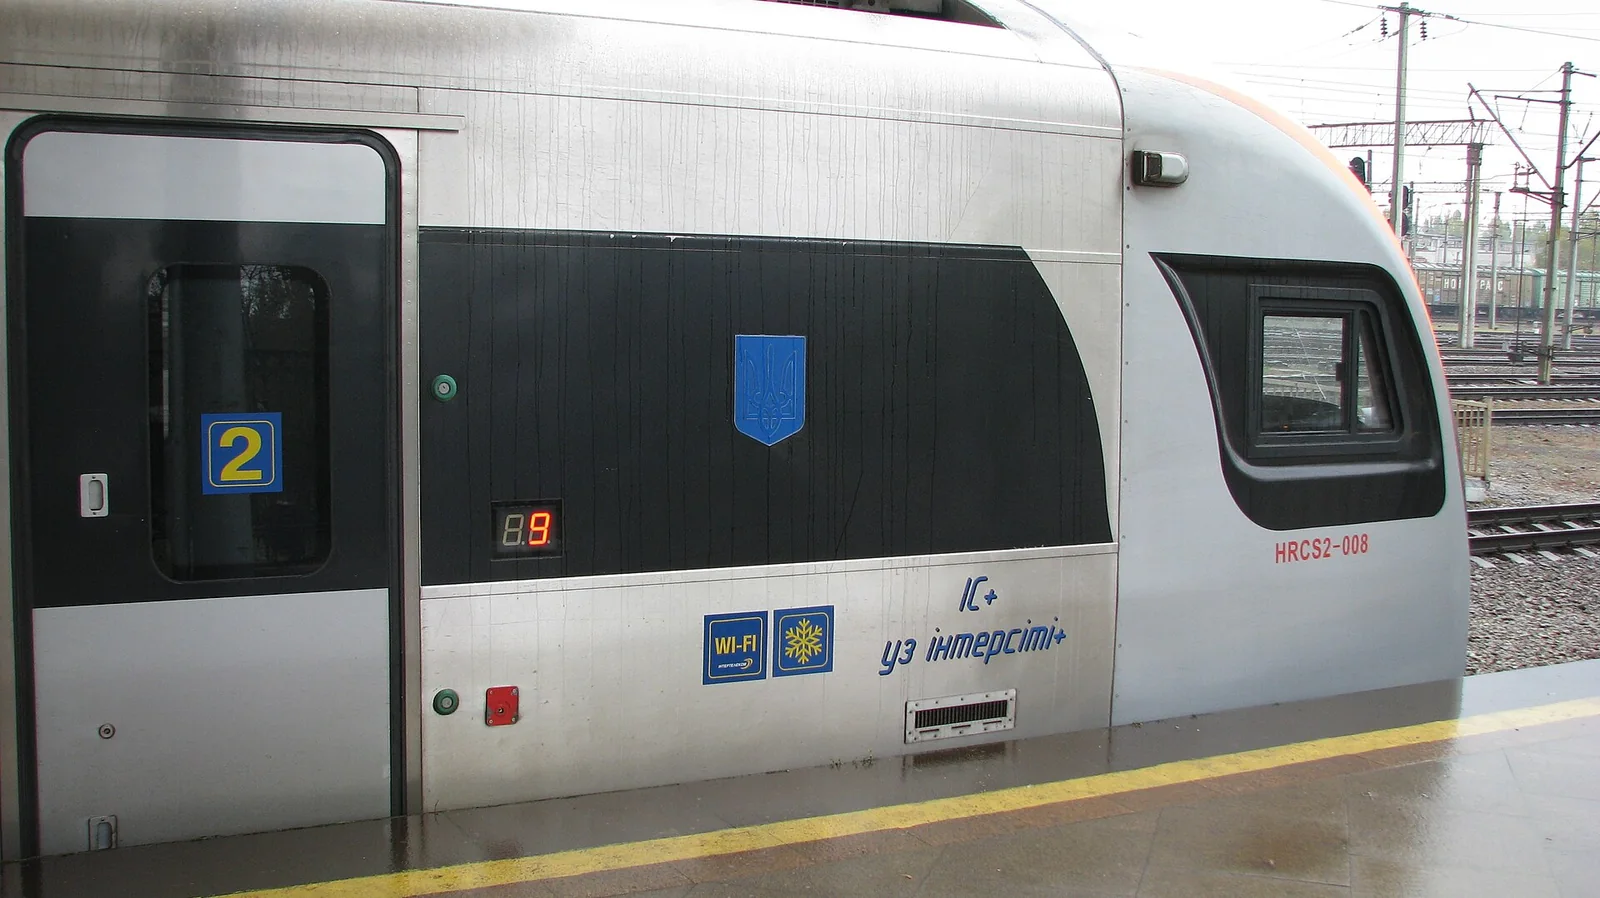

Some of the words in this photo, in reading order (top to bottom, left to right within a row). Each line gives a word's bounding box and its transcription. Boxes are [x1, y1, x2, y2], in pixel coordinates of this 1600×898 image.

[219, 426, 262, 481] 2
[1275, 533, 1368, 564] HRCS2-008
[714, 634, 757, 655] WI-FI
